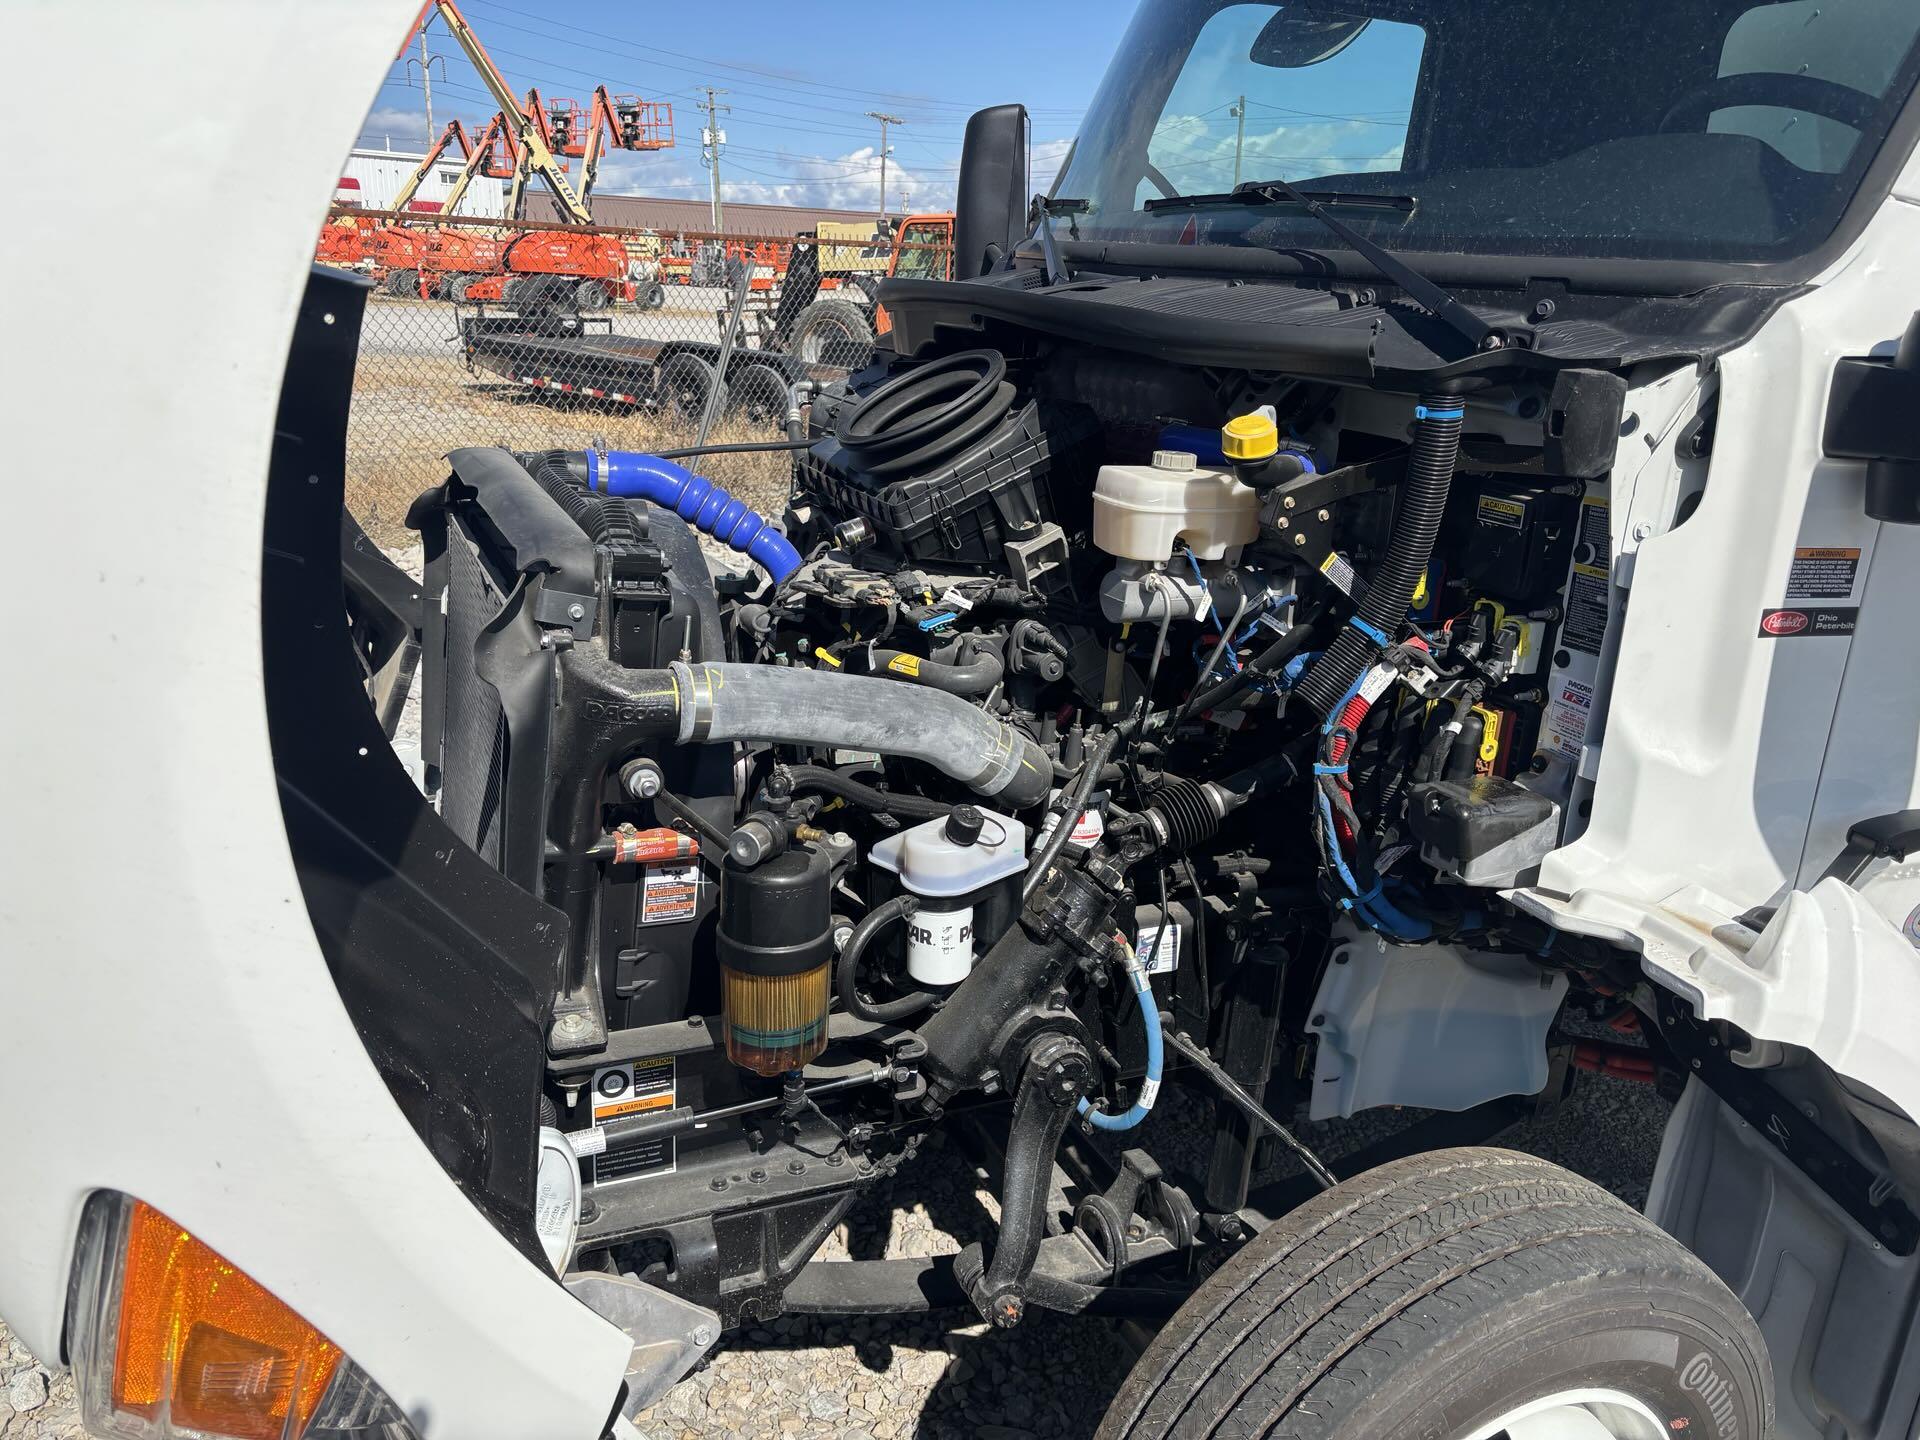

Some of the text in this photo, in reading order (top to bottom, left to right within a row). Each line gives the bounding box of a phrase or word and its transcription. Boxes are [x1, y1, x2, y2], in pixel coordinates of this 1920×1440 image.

[549, 167, 580, 207] JLG LIFT
[1490, 501, 1515, 512] CAUTION
[1768, 614, 1838, 629] Peterbilt Ohio
[1816, 622, 1856, 630] Peterbilt
[1567, 680, 1593, 695] PACCAR
[655, 886, 695, 897] AVERTISSEMENT
[656, 902, 692, 912] ADVERTENCIA
[640, 1056, 673, 1067] CAUTION
[624, 1101, 653, 1111] WARNING
